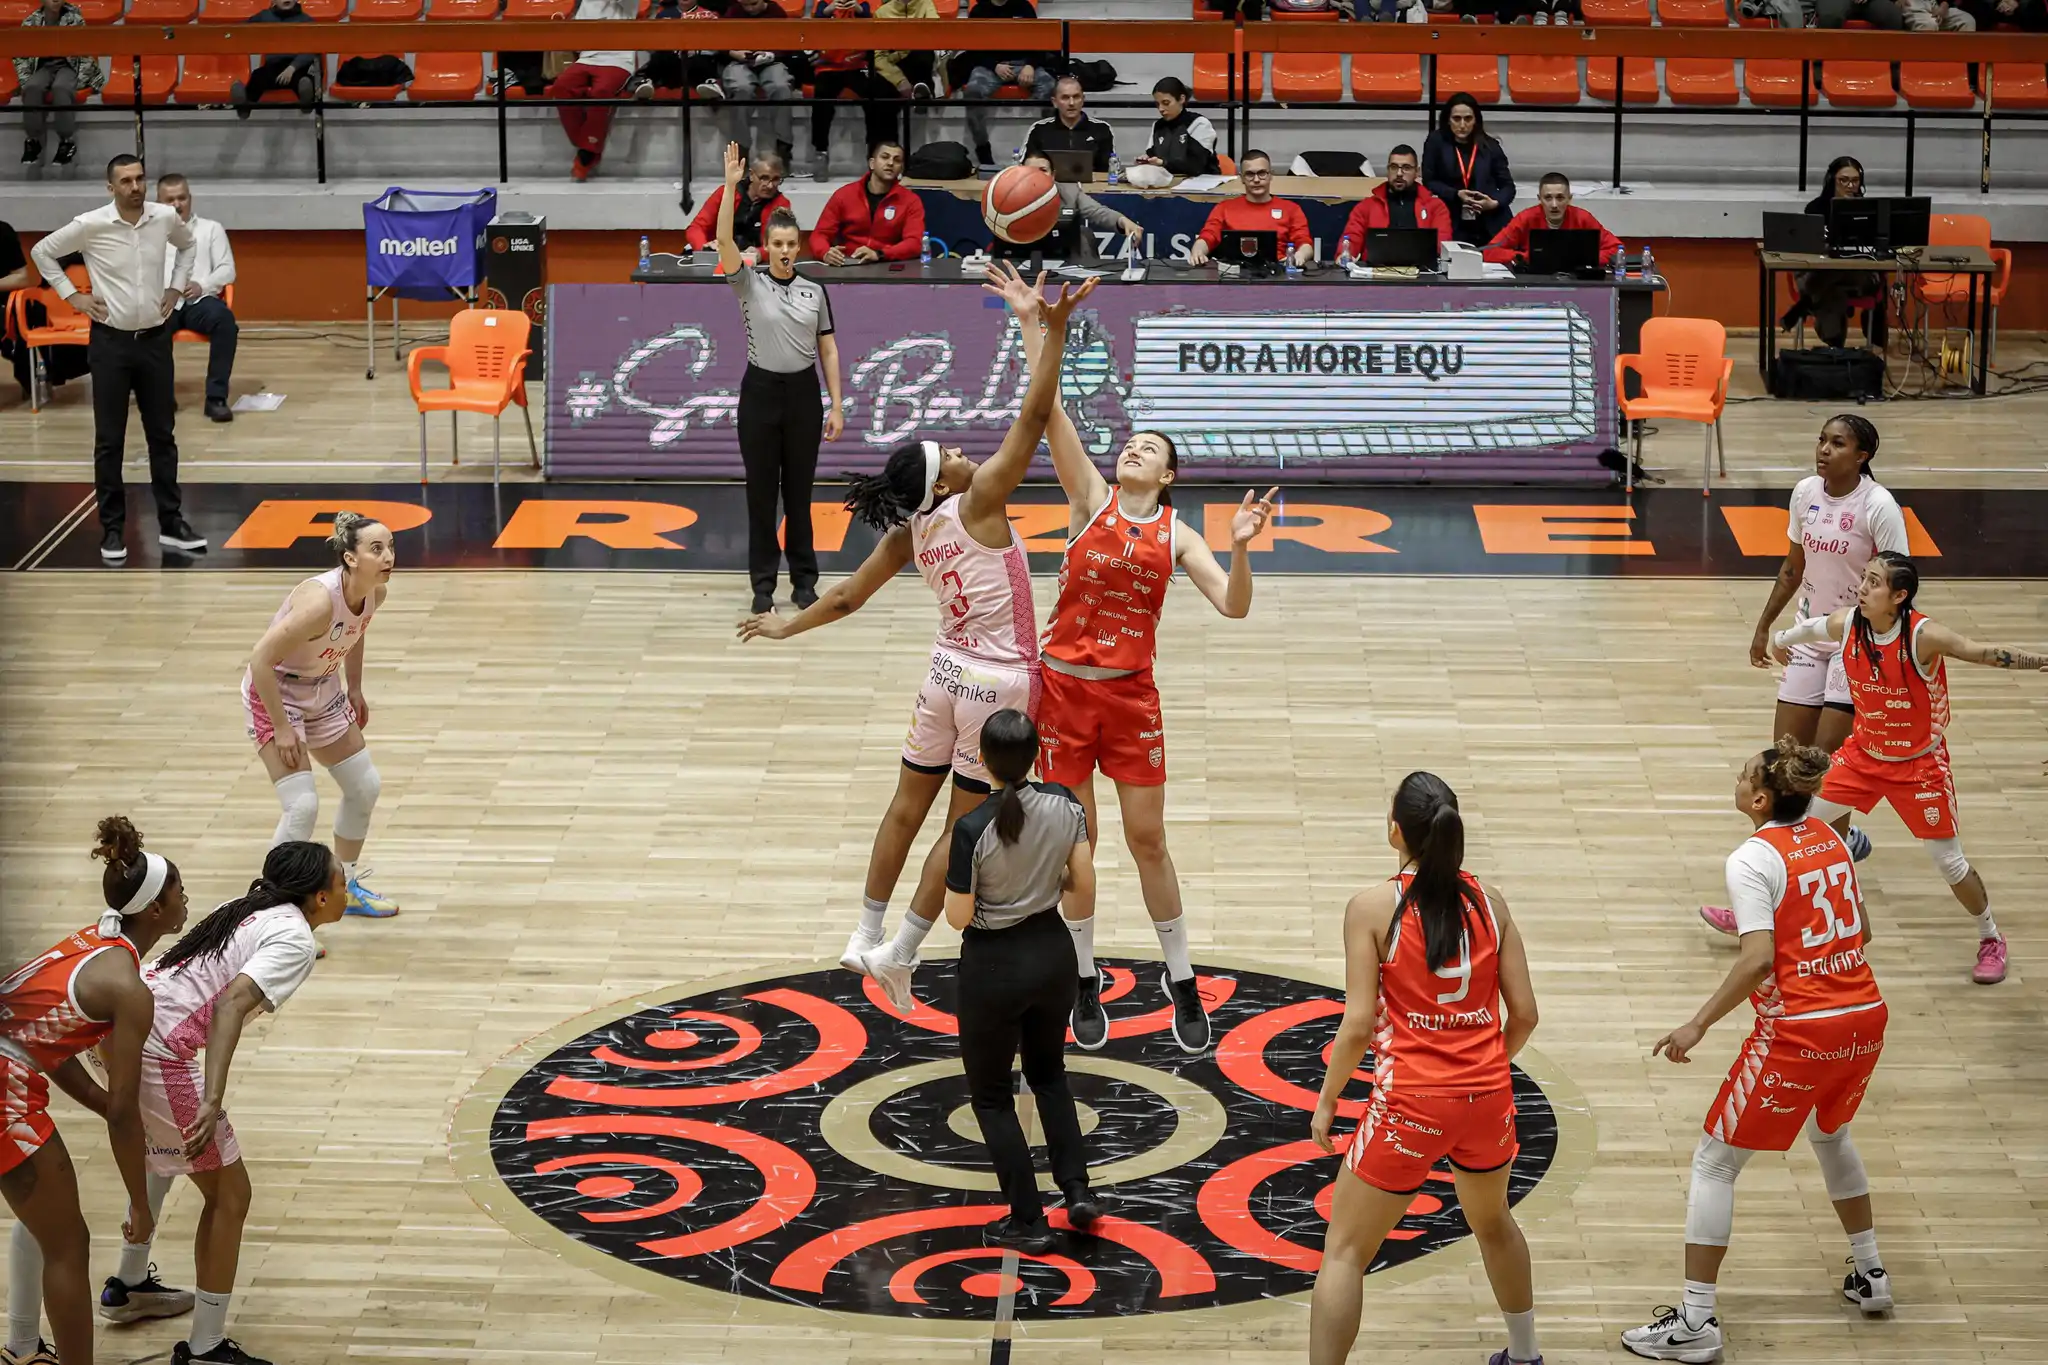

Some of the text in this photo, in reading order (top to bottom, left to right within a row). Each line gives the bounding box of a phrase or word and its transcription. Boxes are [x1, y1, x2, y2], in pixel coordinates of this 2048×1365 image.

[380, 236, 458, 257] molten
[1178, 342, 1465, 382] FOR A MORE EQU
[919, 540, 964, 568] POWELL
[1122, 540, 1135, 559] 11
[1803, 532, 1850, 555] Peja03
[1085, 549, 1109, 564] FAT
[941, 570, 970, 619] 3
[1097, 628, 1118, 643] flux
[932, 652, 963, 680] alba
[1861, 683, 1909, 696] GROUP
[1787, 839, 1838, 862] FAT GROUP
[1797, 860, 1862, 949] 33
